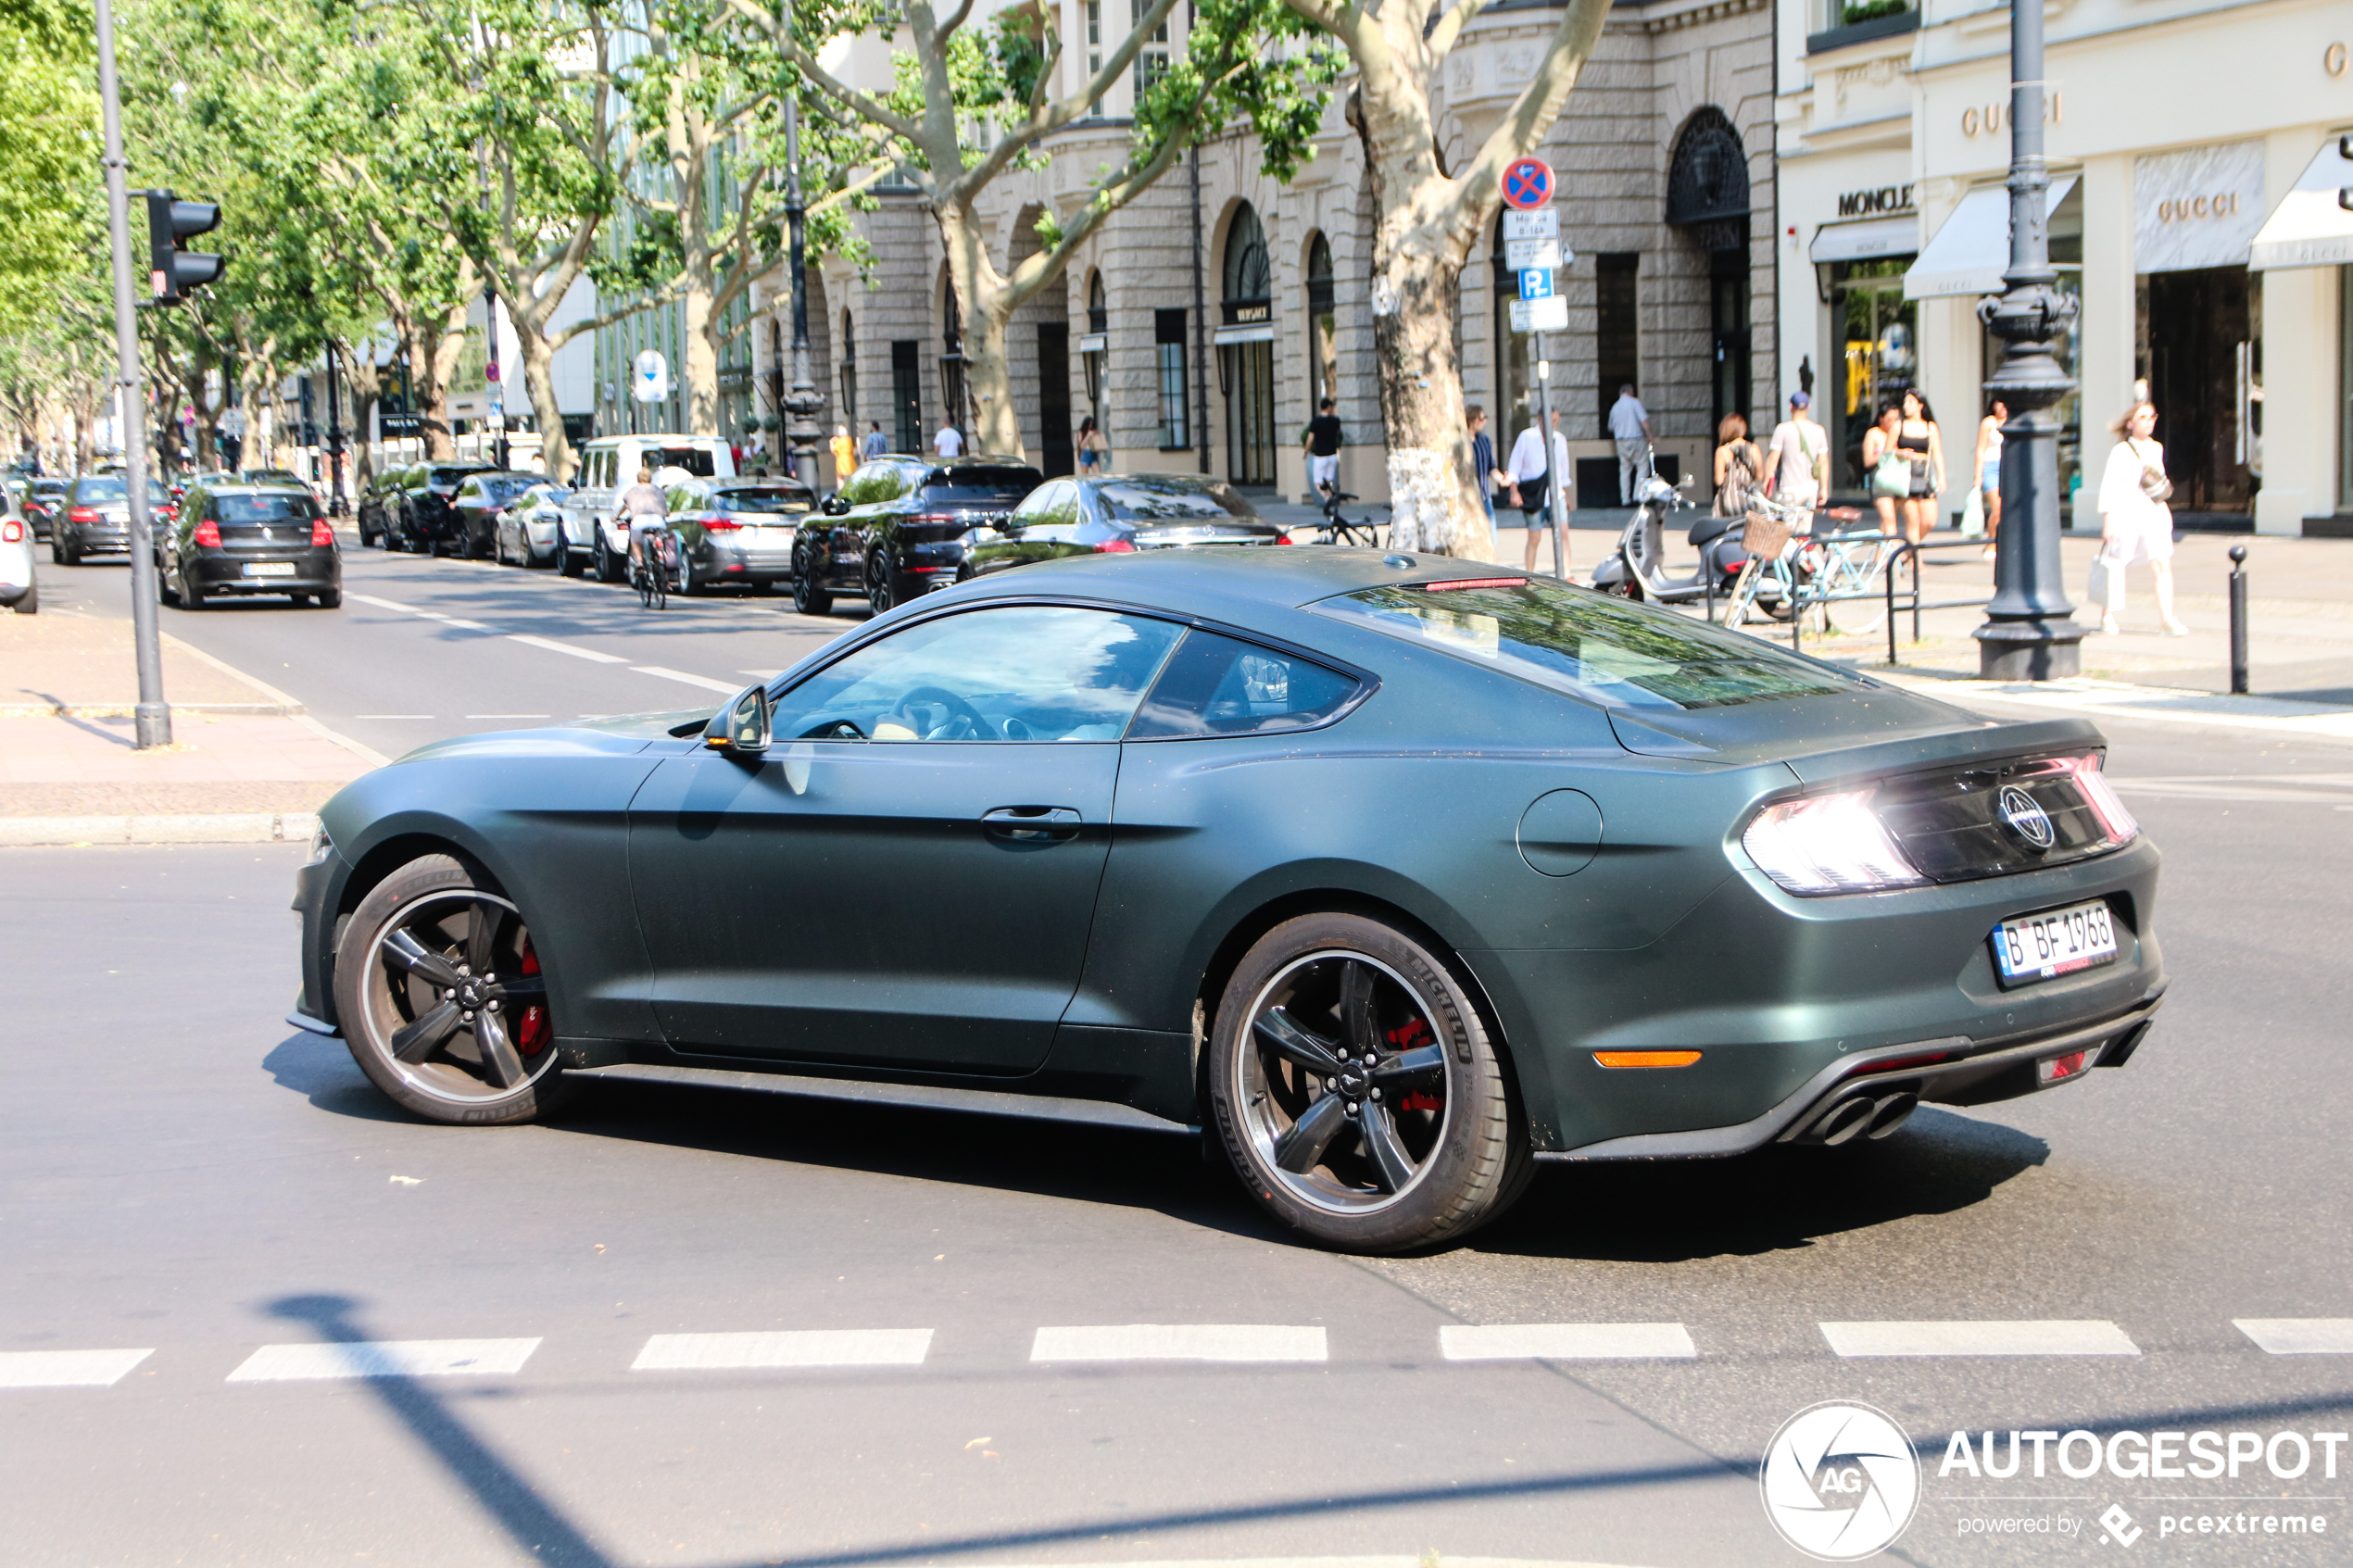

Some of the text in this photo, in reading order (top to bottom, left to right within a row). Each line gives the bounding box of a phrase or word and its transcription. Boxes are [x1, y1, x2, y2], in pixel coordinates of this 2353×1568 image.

[1962, 91, 2062, 138] GUI
[2159, 192, 2240, 224] GUCCI
[2006, 907, 2109, 966] B BF 1968
[1410, 957, 1472, 1060] MICHELIN
